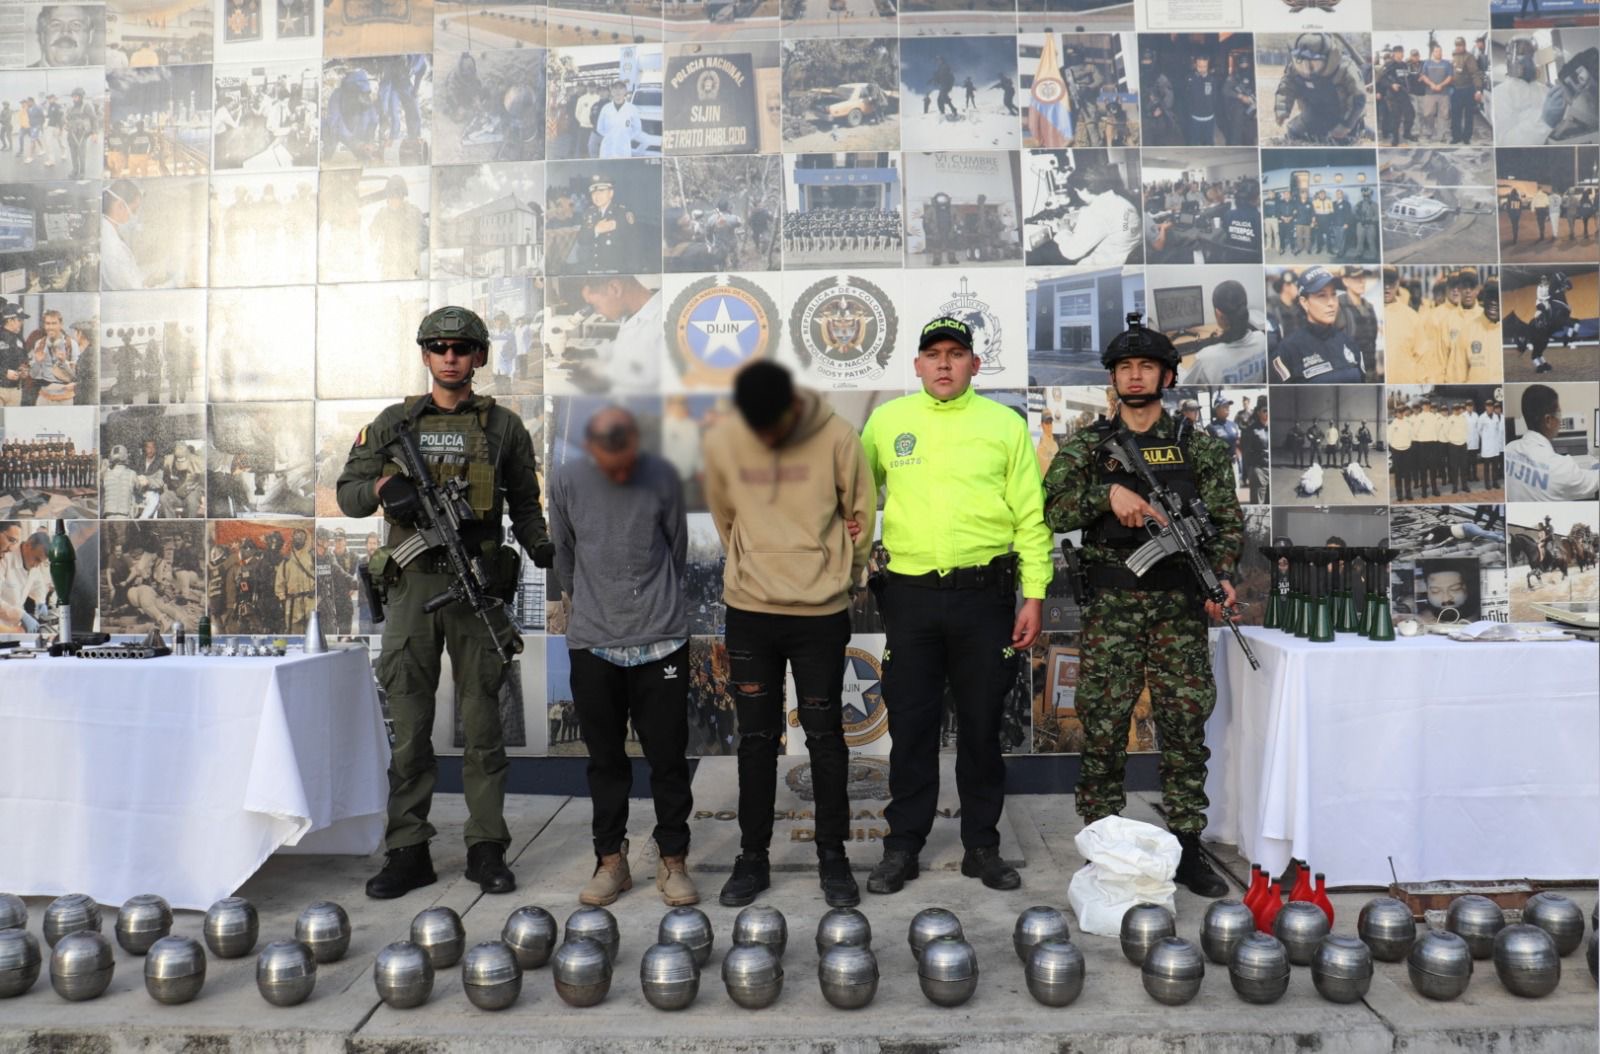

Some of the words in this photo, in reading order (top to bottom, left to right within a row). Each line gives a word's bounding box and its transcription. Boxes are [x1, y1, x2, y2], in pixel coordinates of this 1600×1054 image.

[671, 58, 705, 89] POLICIA
[706, 56, 745, 87] NACIONAL
[690, 105, 721, 122] SIJIN
[663, 128, 704, 149] RETRATO
[705, 126, 746, 147] HABLADO
[858, 291, 886, 334] COLOMBIA
[706, 323, 740, 334] DIJIN
[924, 319, 967, 335] POLICIA
[844, 342, 882, 369] NACIONAL
[844, 364, 873, 379] PATRIA
[420, 433, 465, 447] POLICÍA
[1143, 448, 1176, 463] AULA
[843, 682, 860, 693] IJIN
